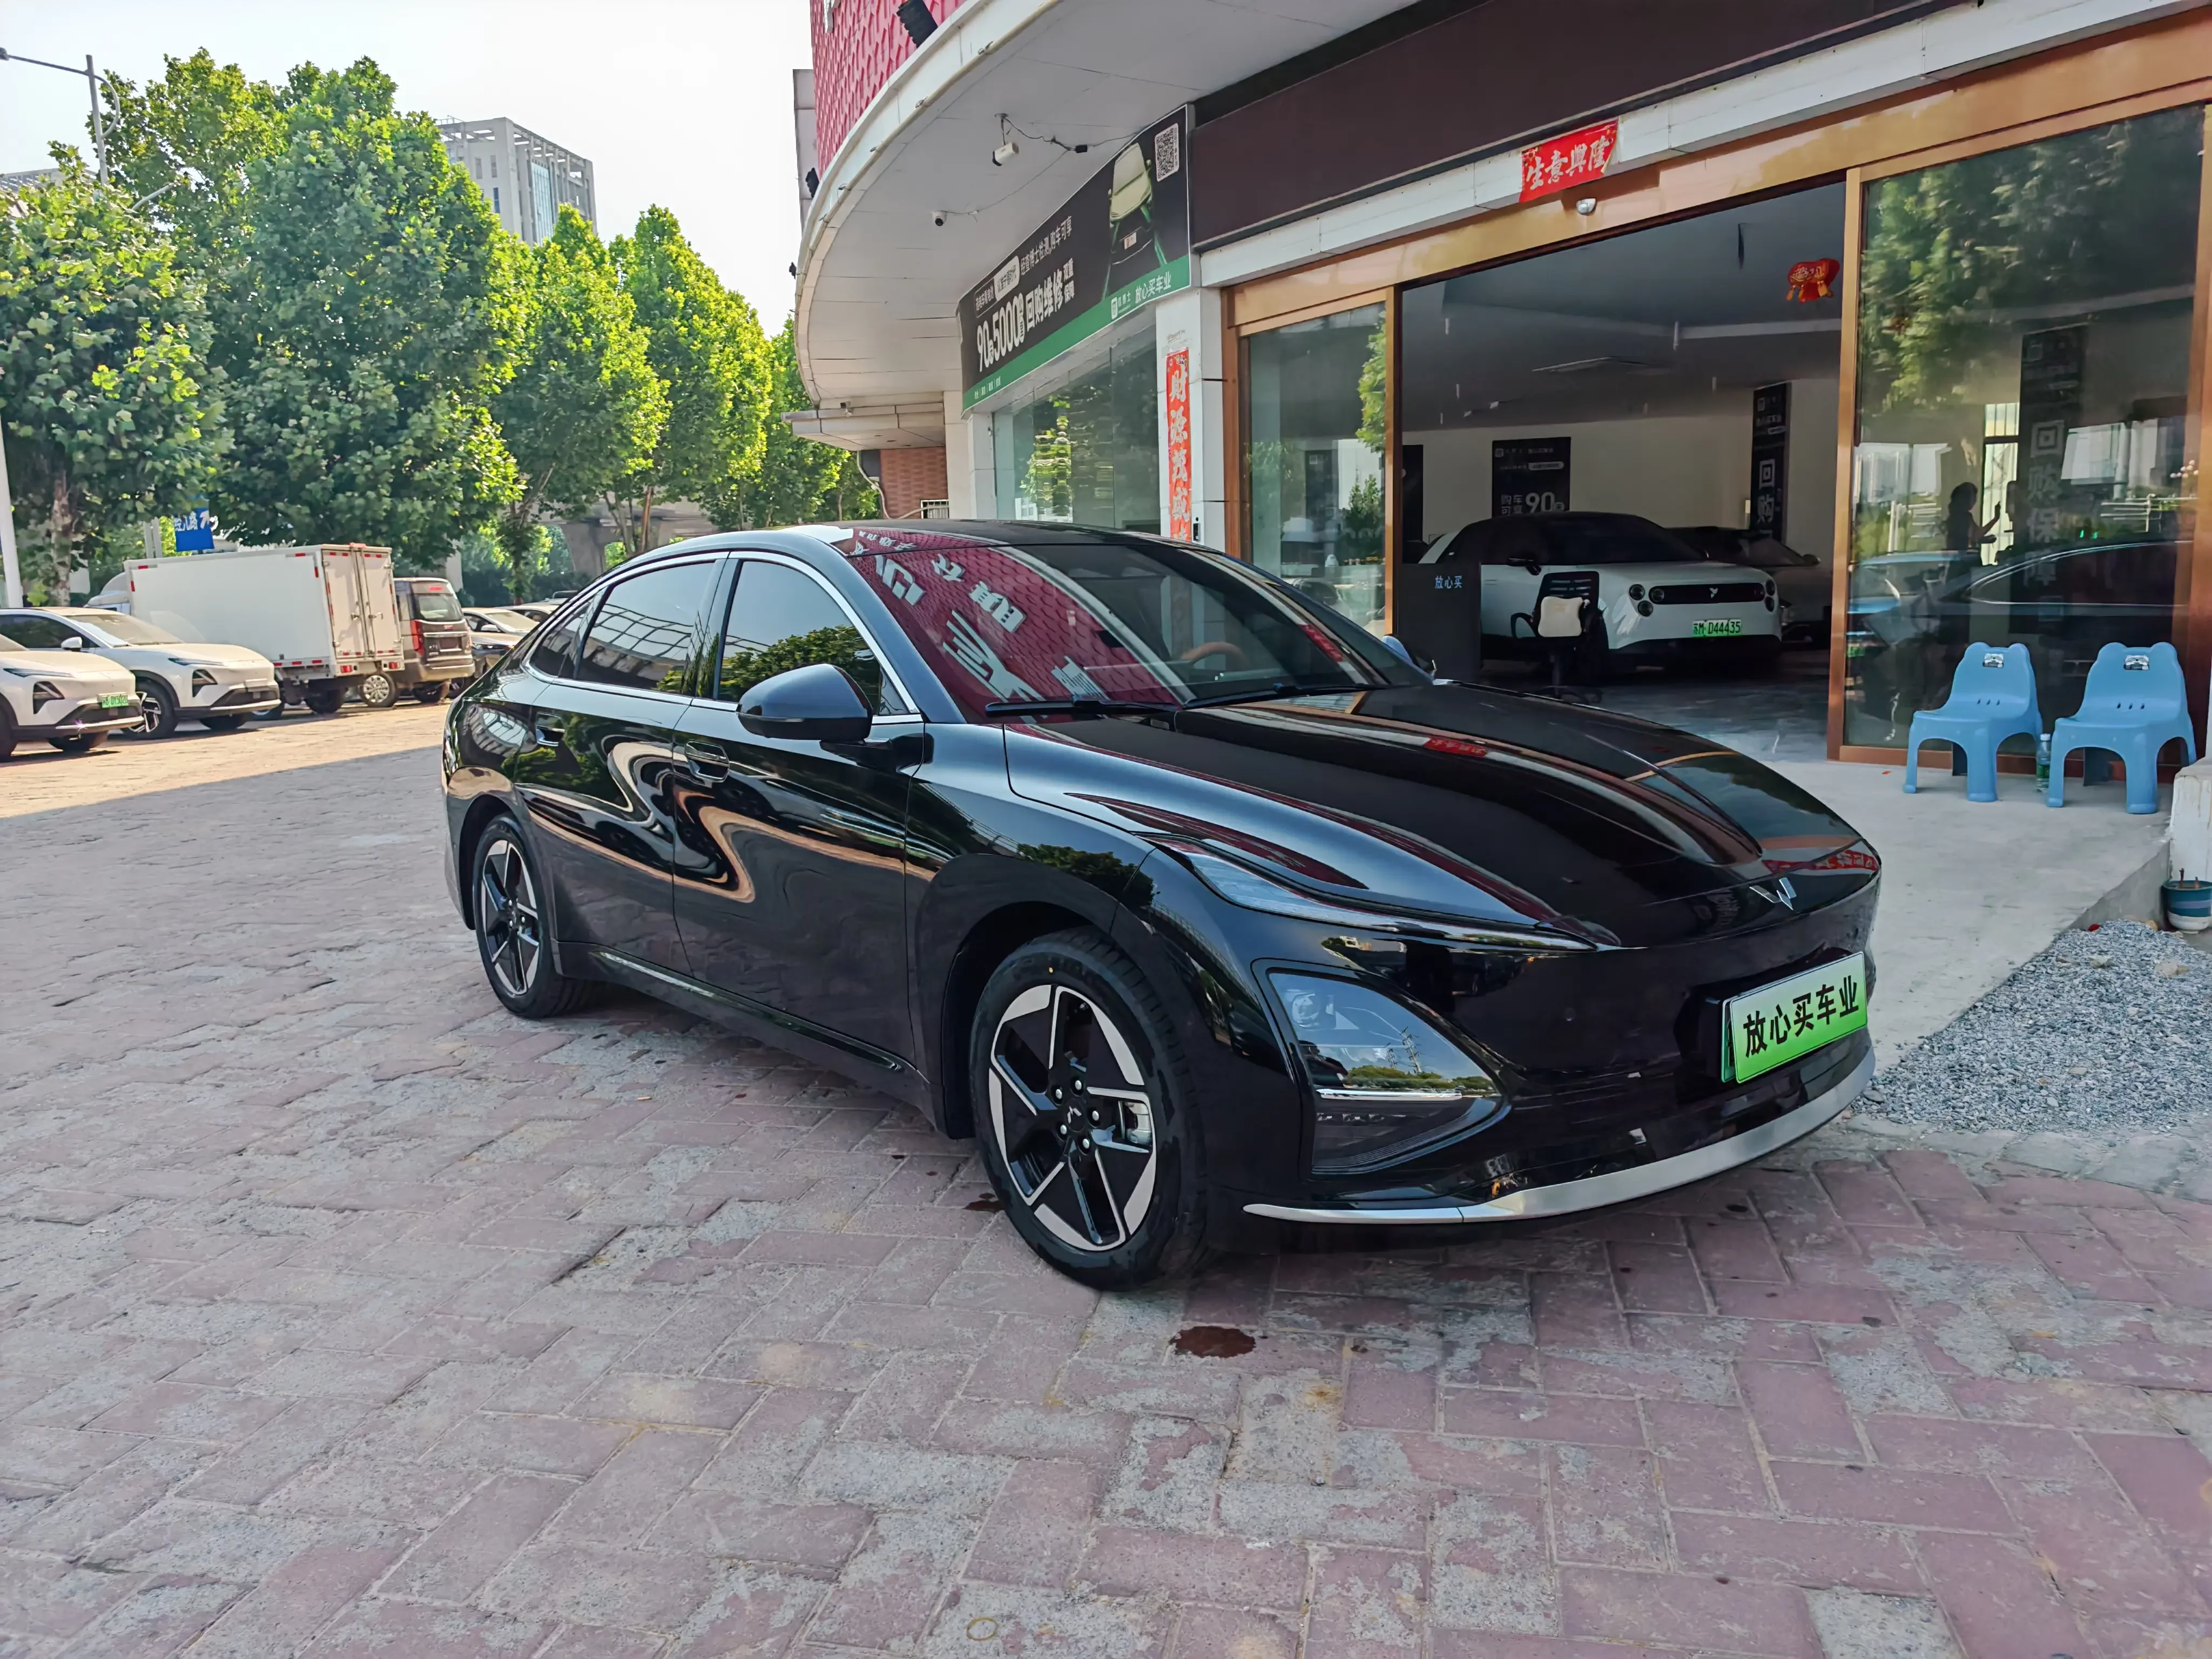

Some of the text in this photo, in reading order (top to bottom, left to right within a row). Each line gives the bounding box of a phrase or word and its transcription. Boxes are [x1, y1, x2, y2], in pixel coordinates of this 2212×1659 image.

[1135, 271, 1171, 304] 放心买车业
[1434, 575, 1463, 589] 放心买
[1743, 974, 1859, 1058] 放心买车业
